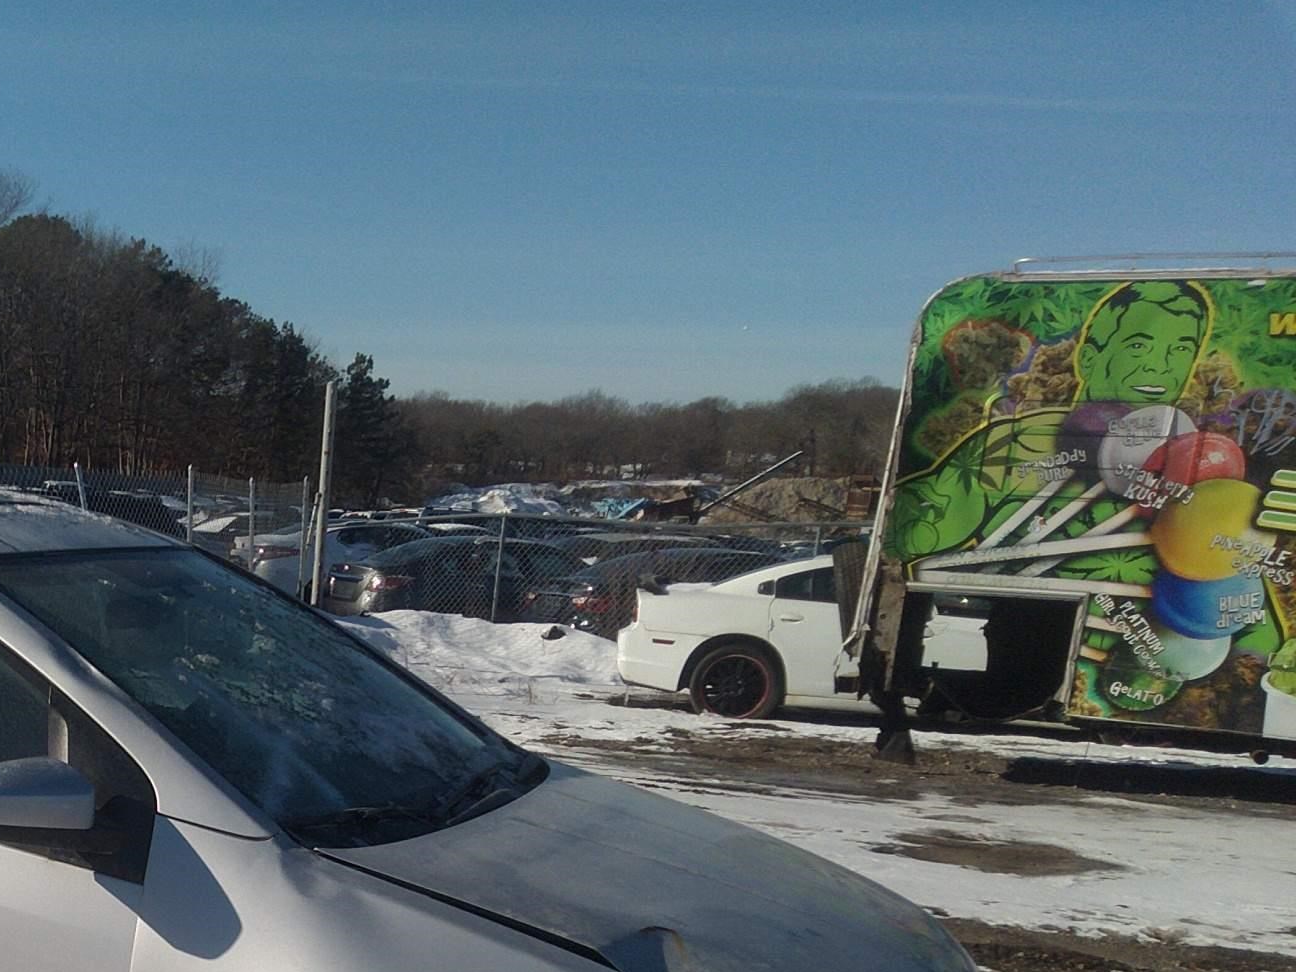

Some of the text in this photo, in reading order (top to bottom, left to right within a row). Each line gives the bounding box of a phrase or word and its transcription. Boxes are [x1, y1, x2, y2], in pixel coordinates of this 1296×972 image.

[1124, 483, 1168, 509] KUSH
[1094, 593, 1115, 615] GIRL
[1218, 592, 1262, 614] BLUE
[1119, 600, 1165, 655] PLATINUM
